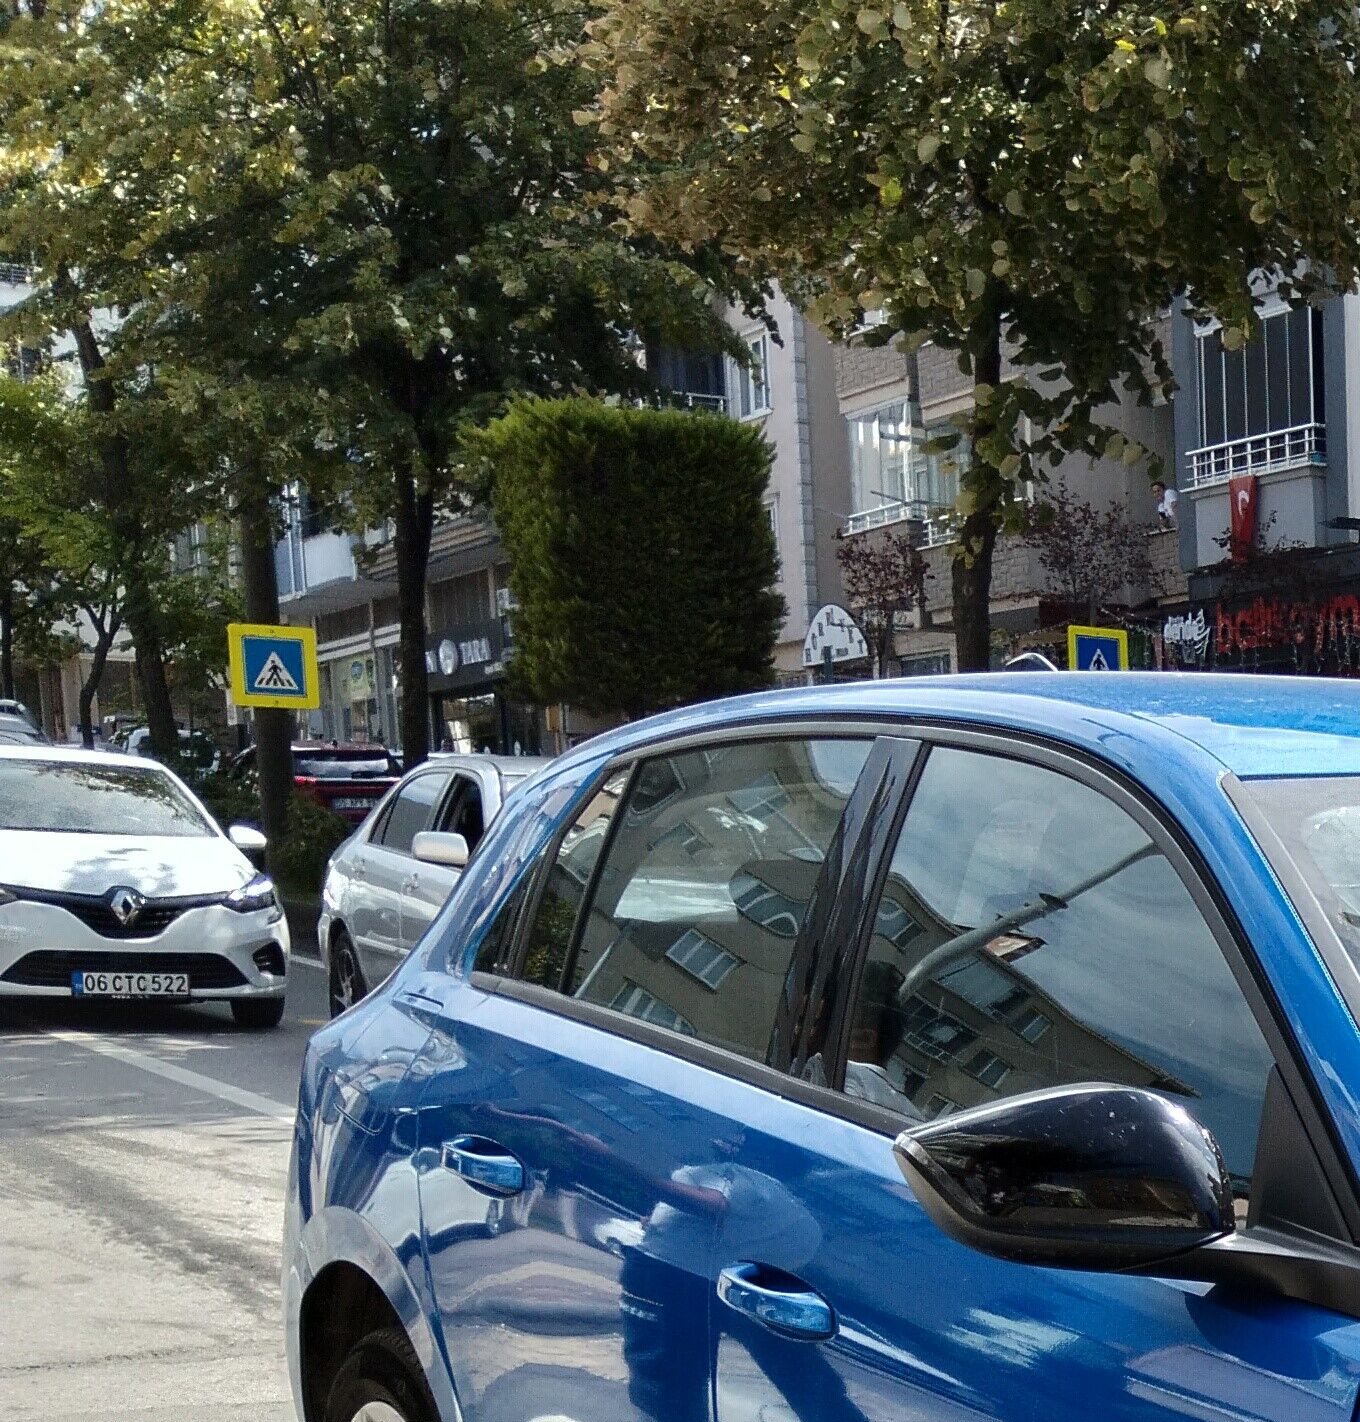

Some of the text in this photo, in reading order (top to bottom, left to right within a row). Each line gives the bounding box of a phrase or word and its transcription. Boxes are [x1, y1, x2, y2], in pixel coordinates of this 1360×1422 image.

[85, 974, 186, 993] 06 CTC 522
